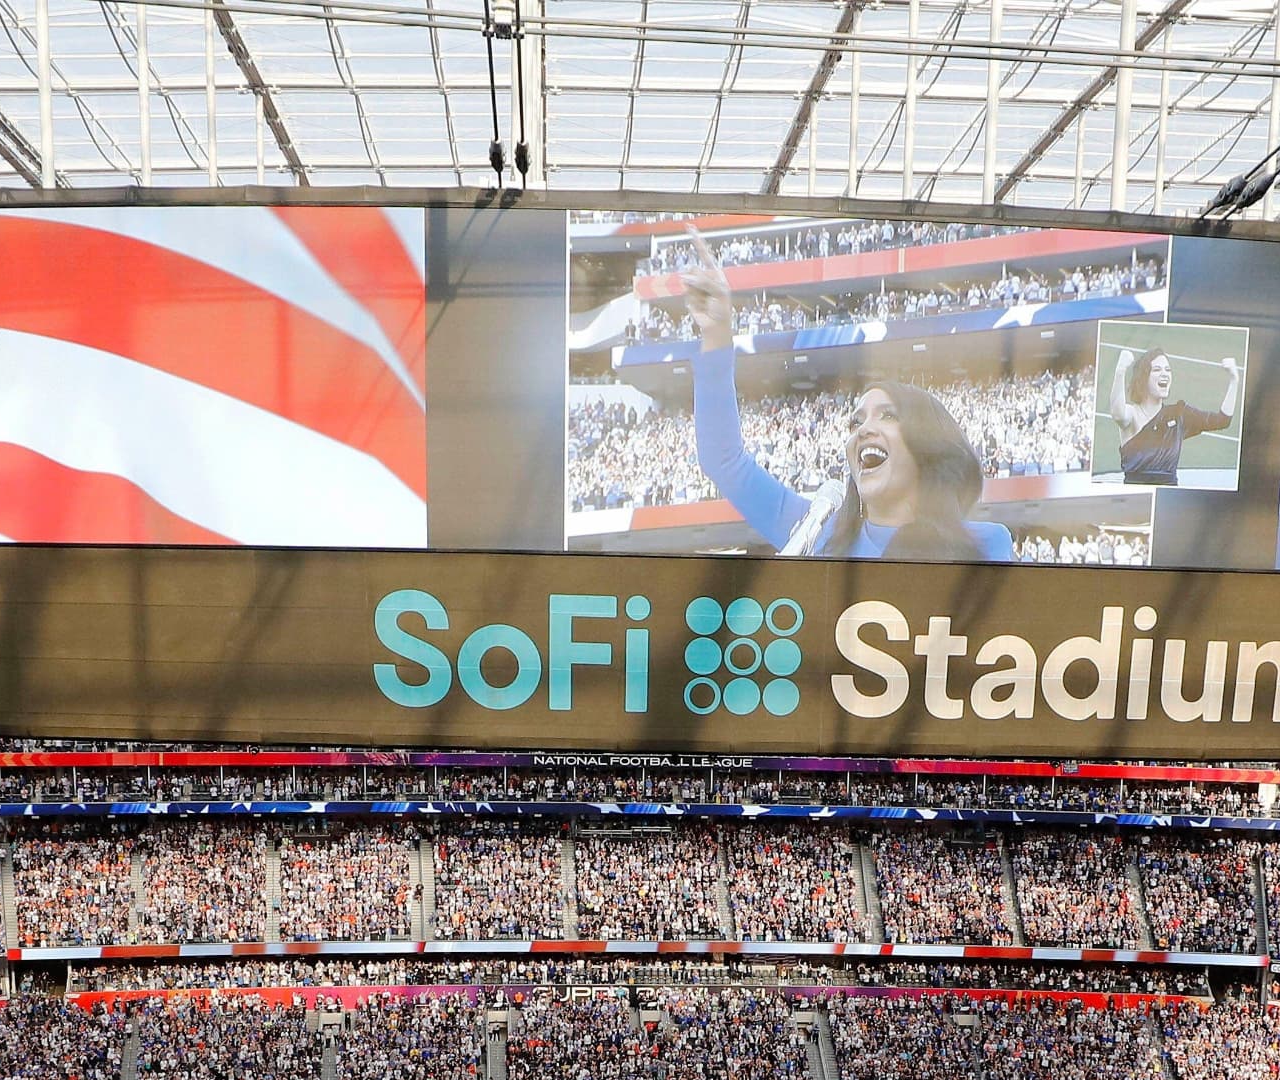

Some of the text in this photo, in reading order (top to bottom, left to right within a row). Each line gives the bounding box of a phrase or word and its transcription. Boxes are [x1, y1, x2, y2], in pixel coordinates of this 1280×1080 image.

[373, 589, 652, 714] SoFi
[533, 755, 608, 767] NATIONAL
[609, 755, 690, 768] FOOTBAL
